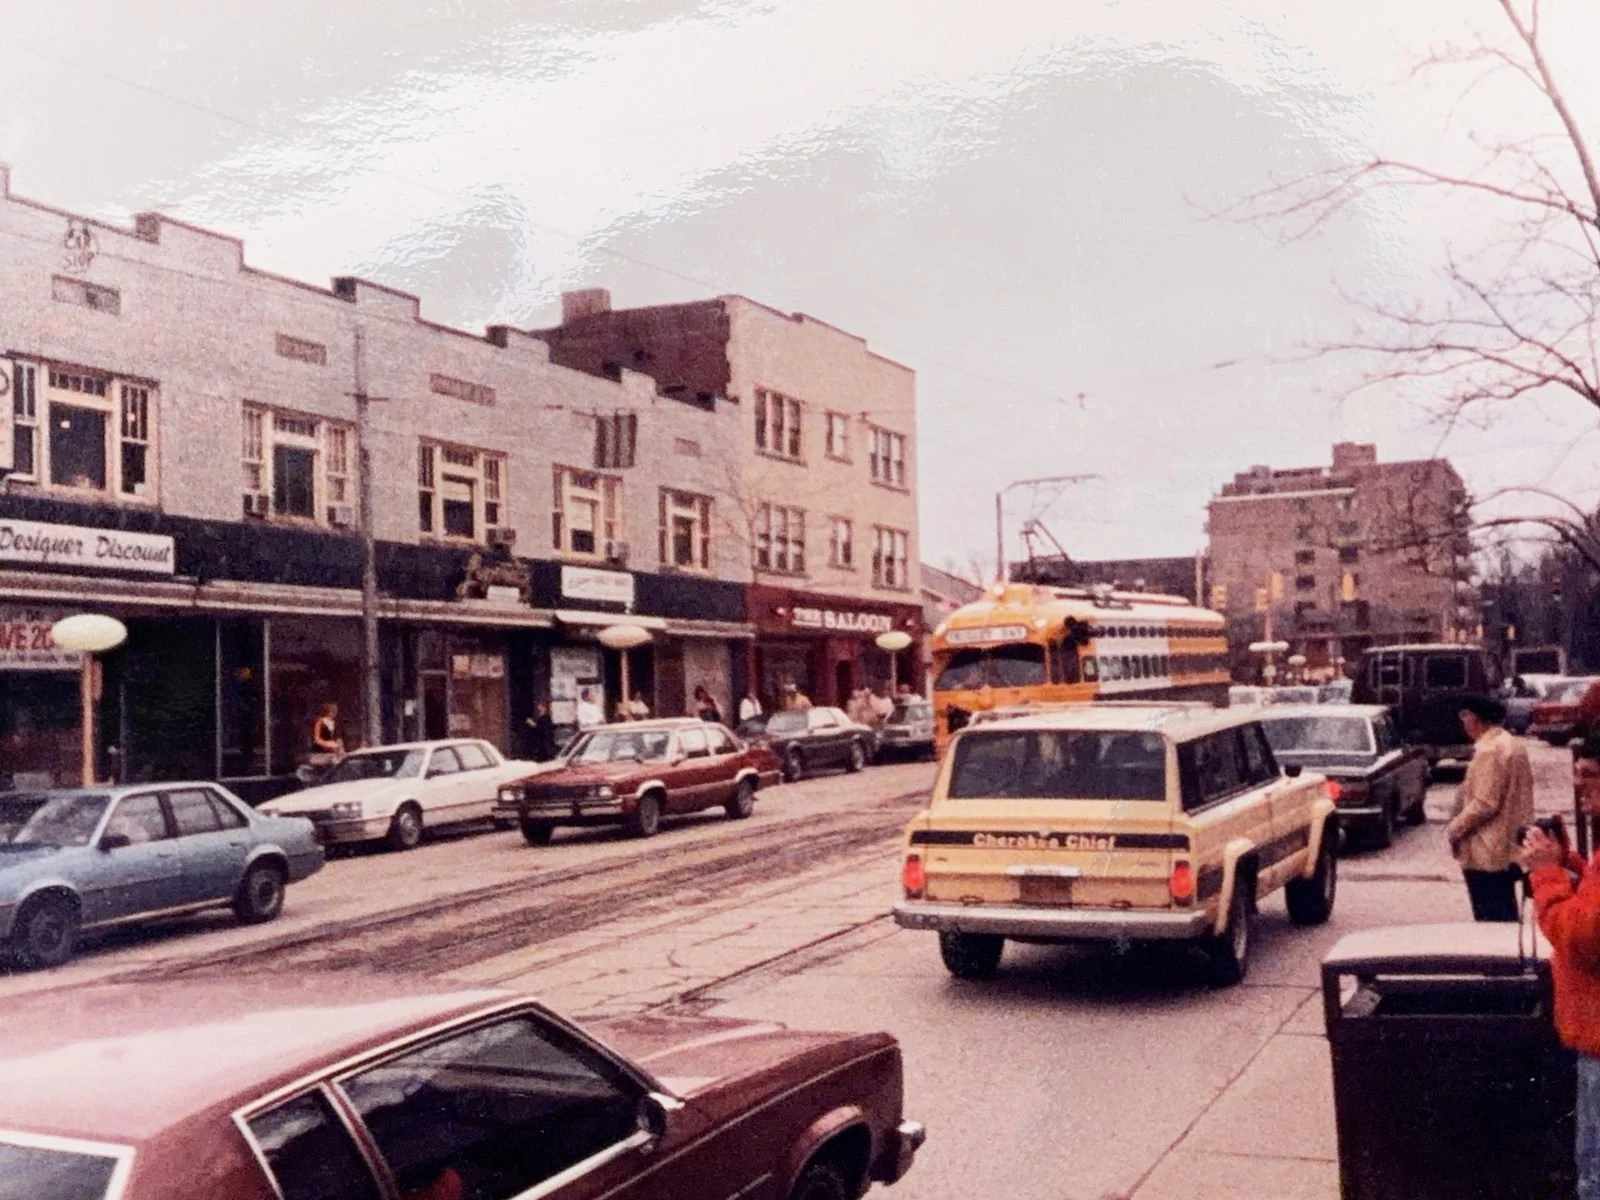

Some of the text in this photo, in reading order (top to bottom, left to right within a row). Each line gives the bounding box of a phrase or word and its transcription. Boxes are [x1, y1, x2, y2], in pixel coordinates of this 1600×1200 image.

[0, 526, 171, 563] Designer Discount
[824, 610, 892, 632] SALOON
[973, 831, 1116, 850] Cherokee Chief
